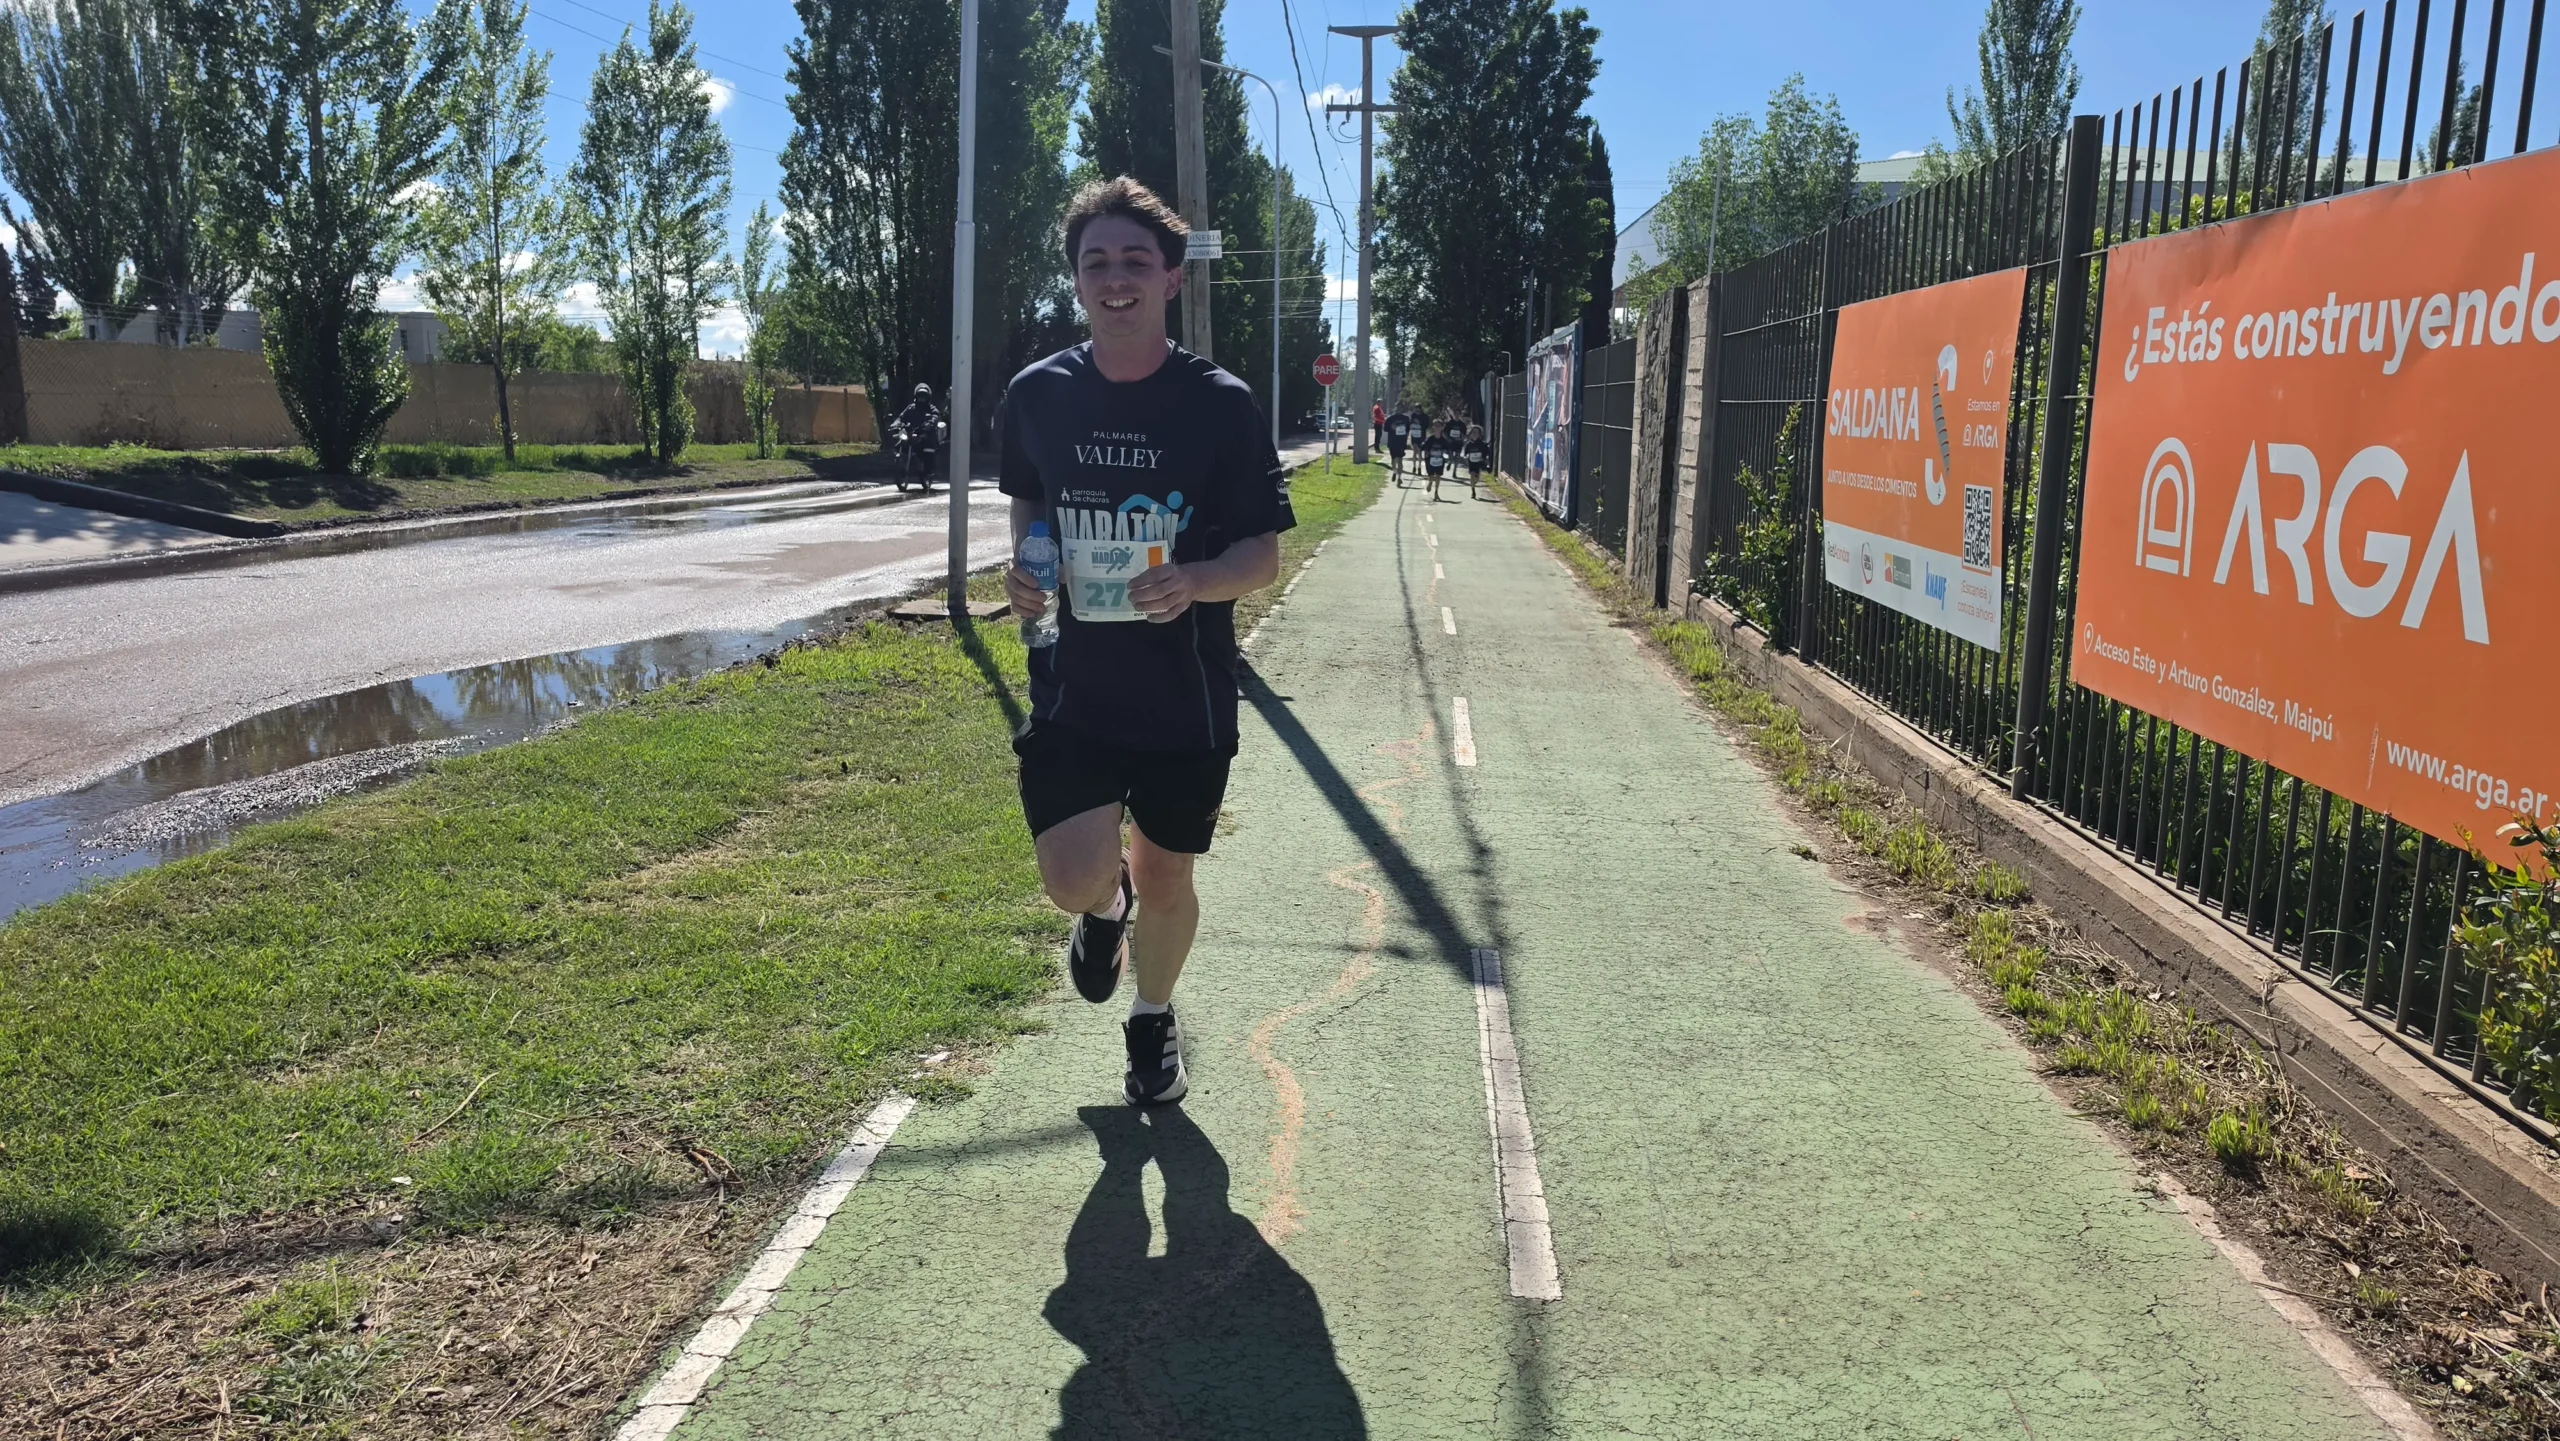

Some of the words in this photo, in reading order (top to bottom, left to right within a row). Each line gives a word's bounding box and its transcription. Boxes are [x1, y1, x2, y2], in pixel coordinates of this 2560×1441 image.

[2124, 300, 2226, 383] ¿Estás
[2233, 251, 2560, 376] construyendo
[1313, 365, 1340, 375] PARE
[1829, 386, 1920, 442] SALDAÑA
[1967, 398, 1992, 412] Estamos
[1992, 401, 2000, 412] en
[1093, 431, 1148, 442] PALMARES
[1972, 424, 1999, 449] ARGA
[1074, 444, 1164, 469] VALLEY
[1827, 469, 1842, 485] JUNTO
[1846, 472, 1857, 487] VOS
[1857, 474, 1874, 490] DESDE
[1874, 476, 1885, 492] LOS
[1885, 478, 1918, 499] CIMIENTOS
[1082, 496, 1111, 504] chacras
[1056, 503, 1180, 552] MARATÓN
[2212, 439, 2491, 646] ARGA
[2093, 633, 2130, 665] Acceso
[2132, 646, 2157, 675] Este
[2157, 661, 2167, 684] y
[2168, 659, 2209, 694] Arturo
[2212, 674, 2279, 725] González,
[2283, 698, 2334, 743] Maipú
[2386, 739, 2549, 819] www.arga.ar
